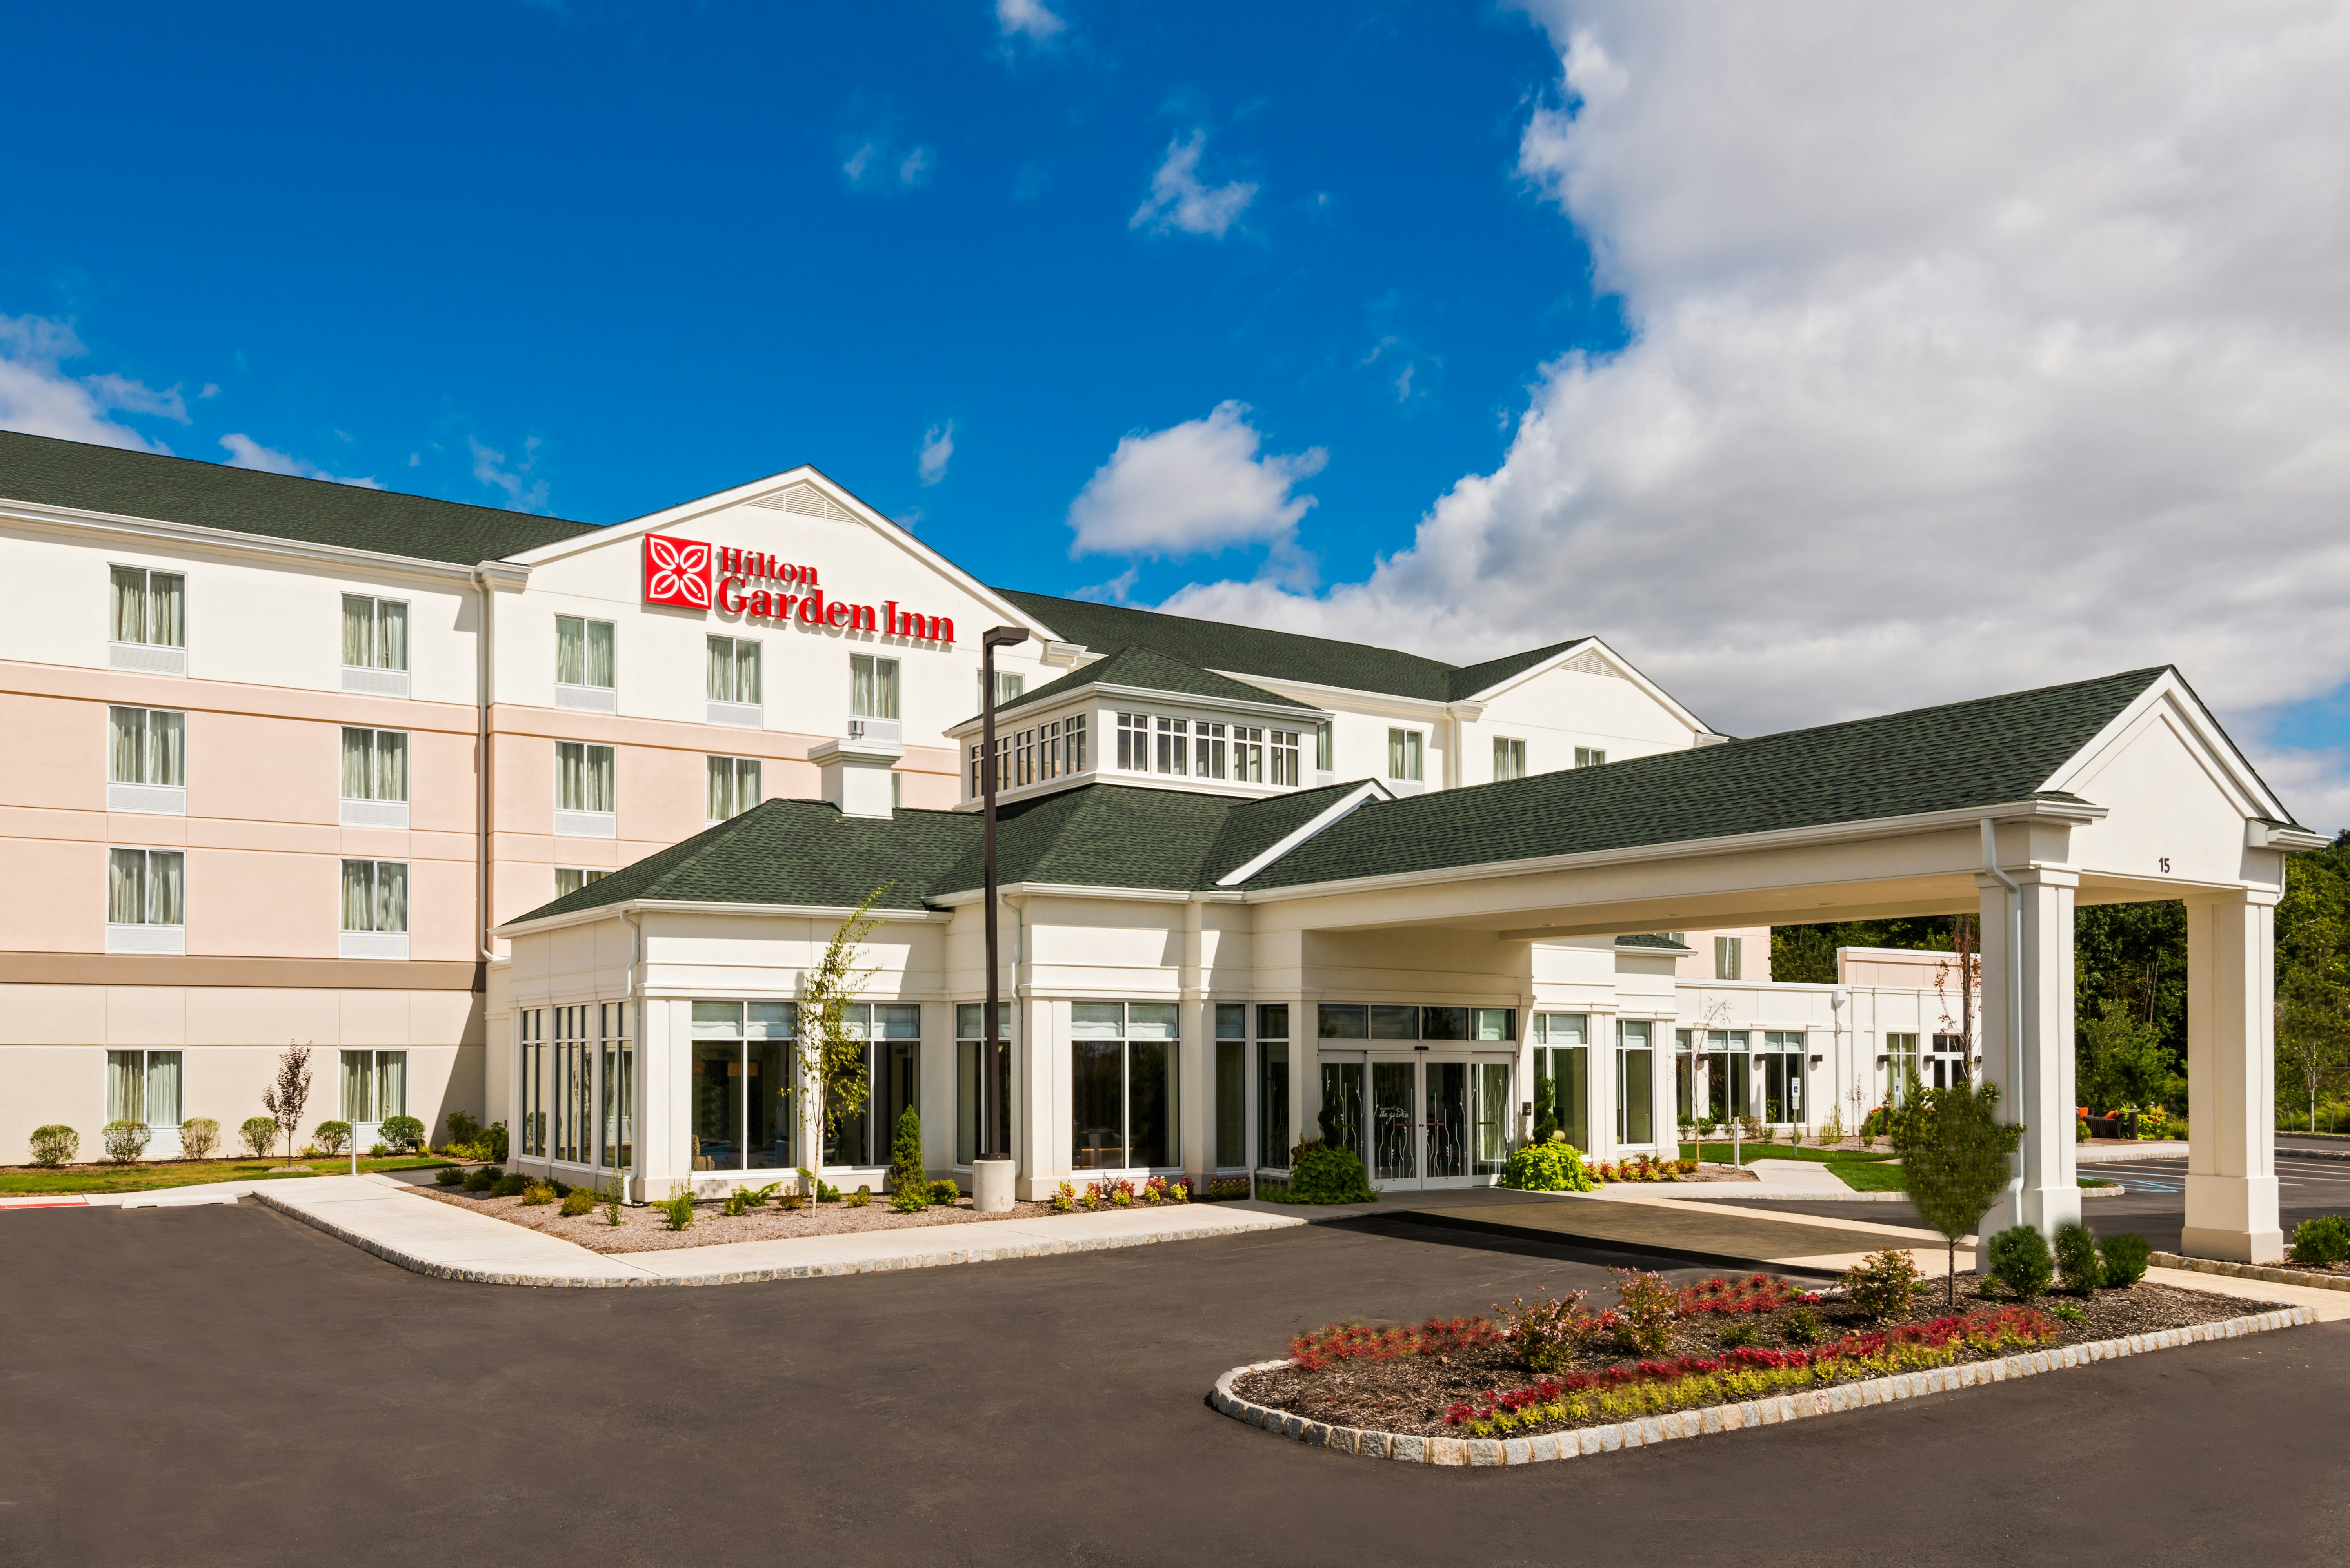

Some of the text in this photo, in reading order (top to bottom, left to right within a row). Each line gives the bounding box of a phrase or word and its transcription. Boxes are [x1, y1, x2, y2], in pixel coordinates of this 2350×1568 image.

[719, 546, 820, 586] Hilton
[717, 575, 957, 643] Garden Inn
[2159, 857, 2170, 873] 15
[1385, 1108, 1409, 1125] garden
